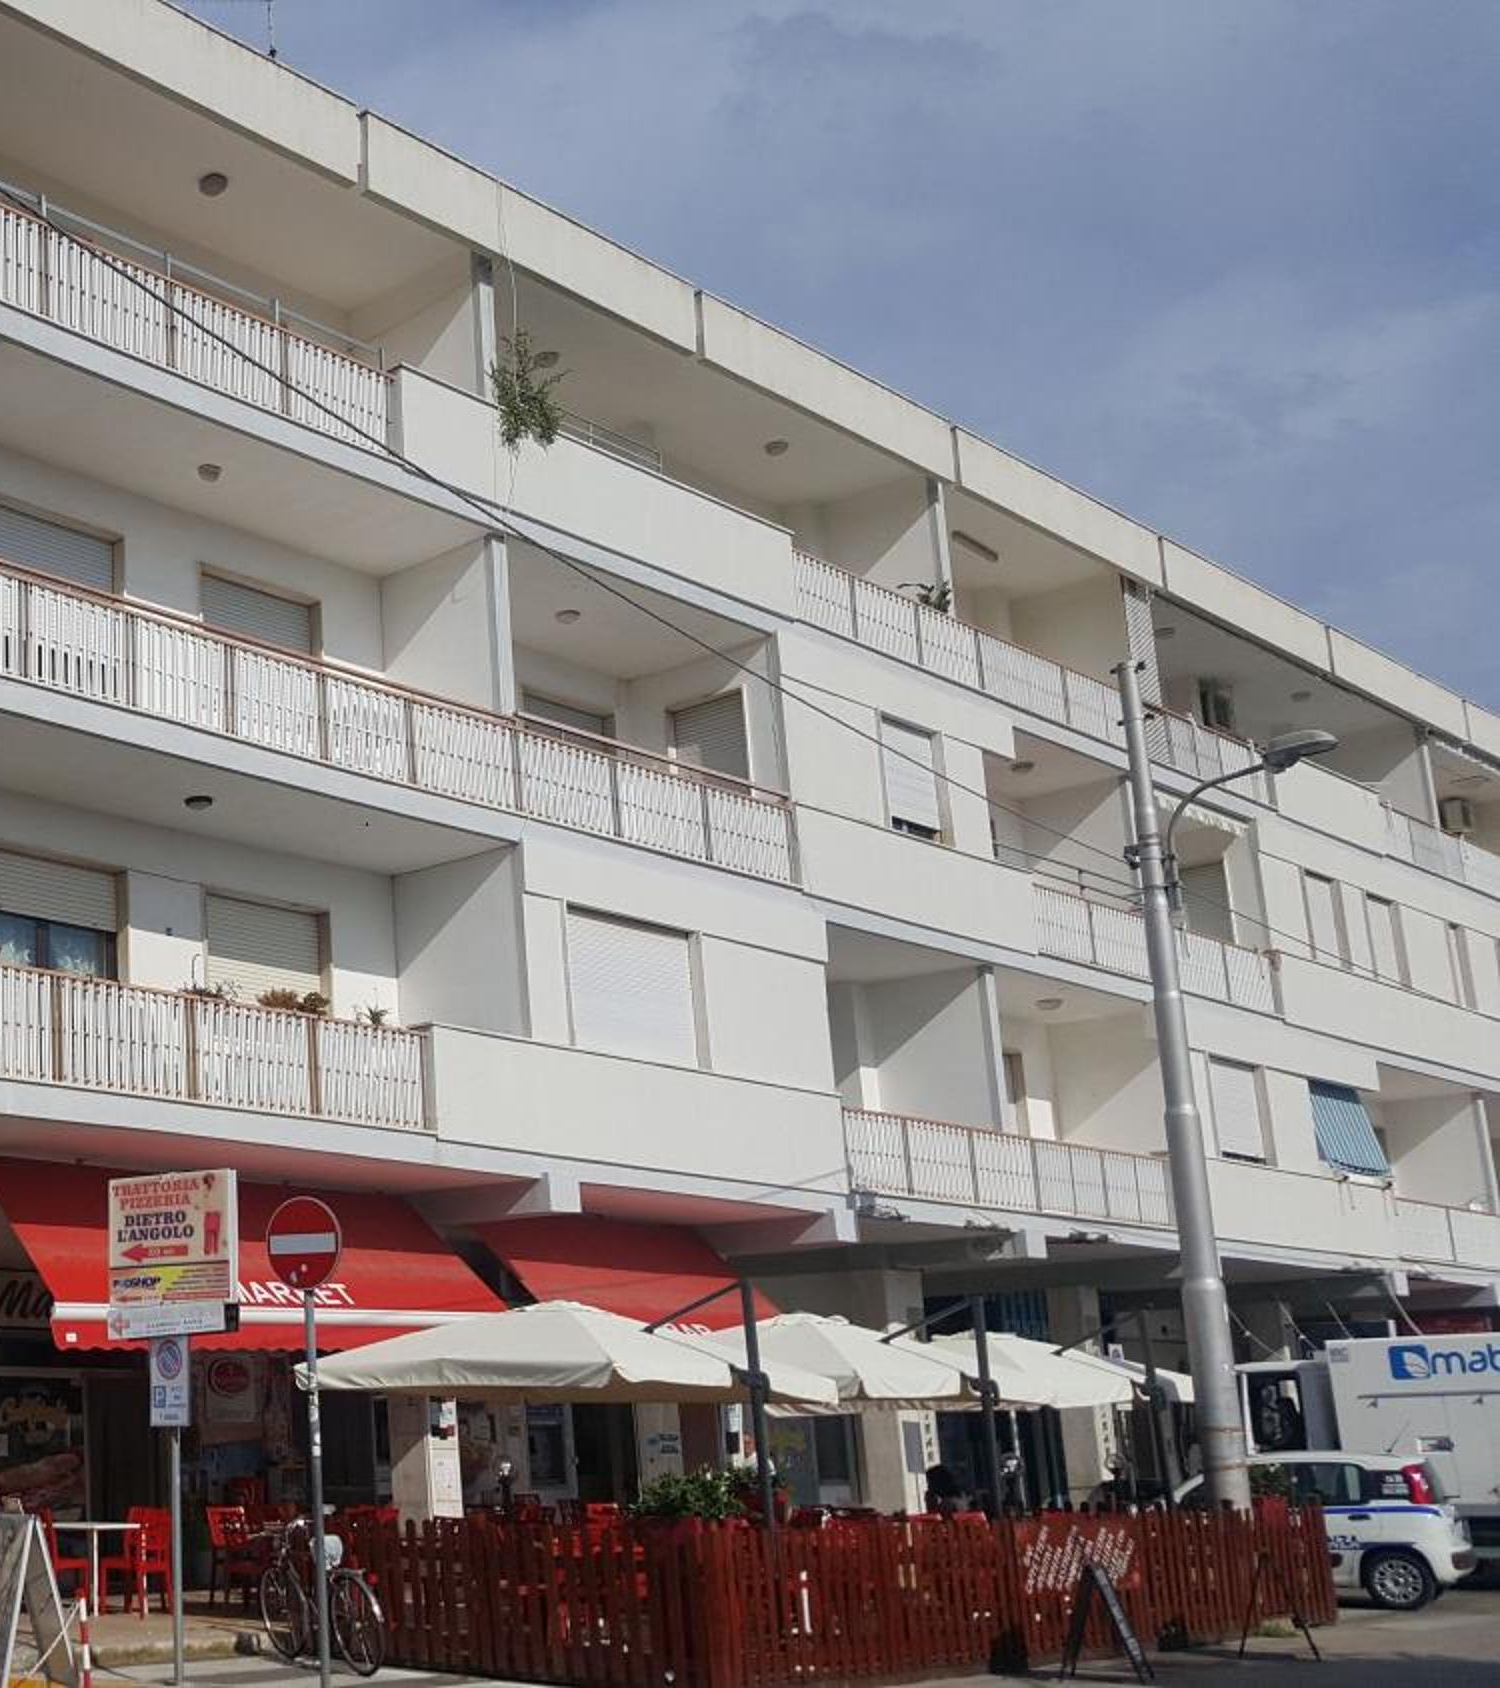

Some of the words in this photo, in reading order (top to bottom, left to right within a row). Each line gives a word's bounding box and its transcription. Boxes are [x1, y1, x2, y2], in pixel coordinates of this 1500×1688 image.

[112, 1180, 199, 1197] TRATTORIA
[119, 1194, 191, 1210] PIZZERIA
[124, 1211, 186, 1227] DIETRO
[117, 1224, 194, 1243] L'ANGOLO
